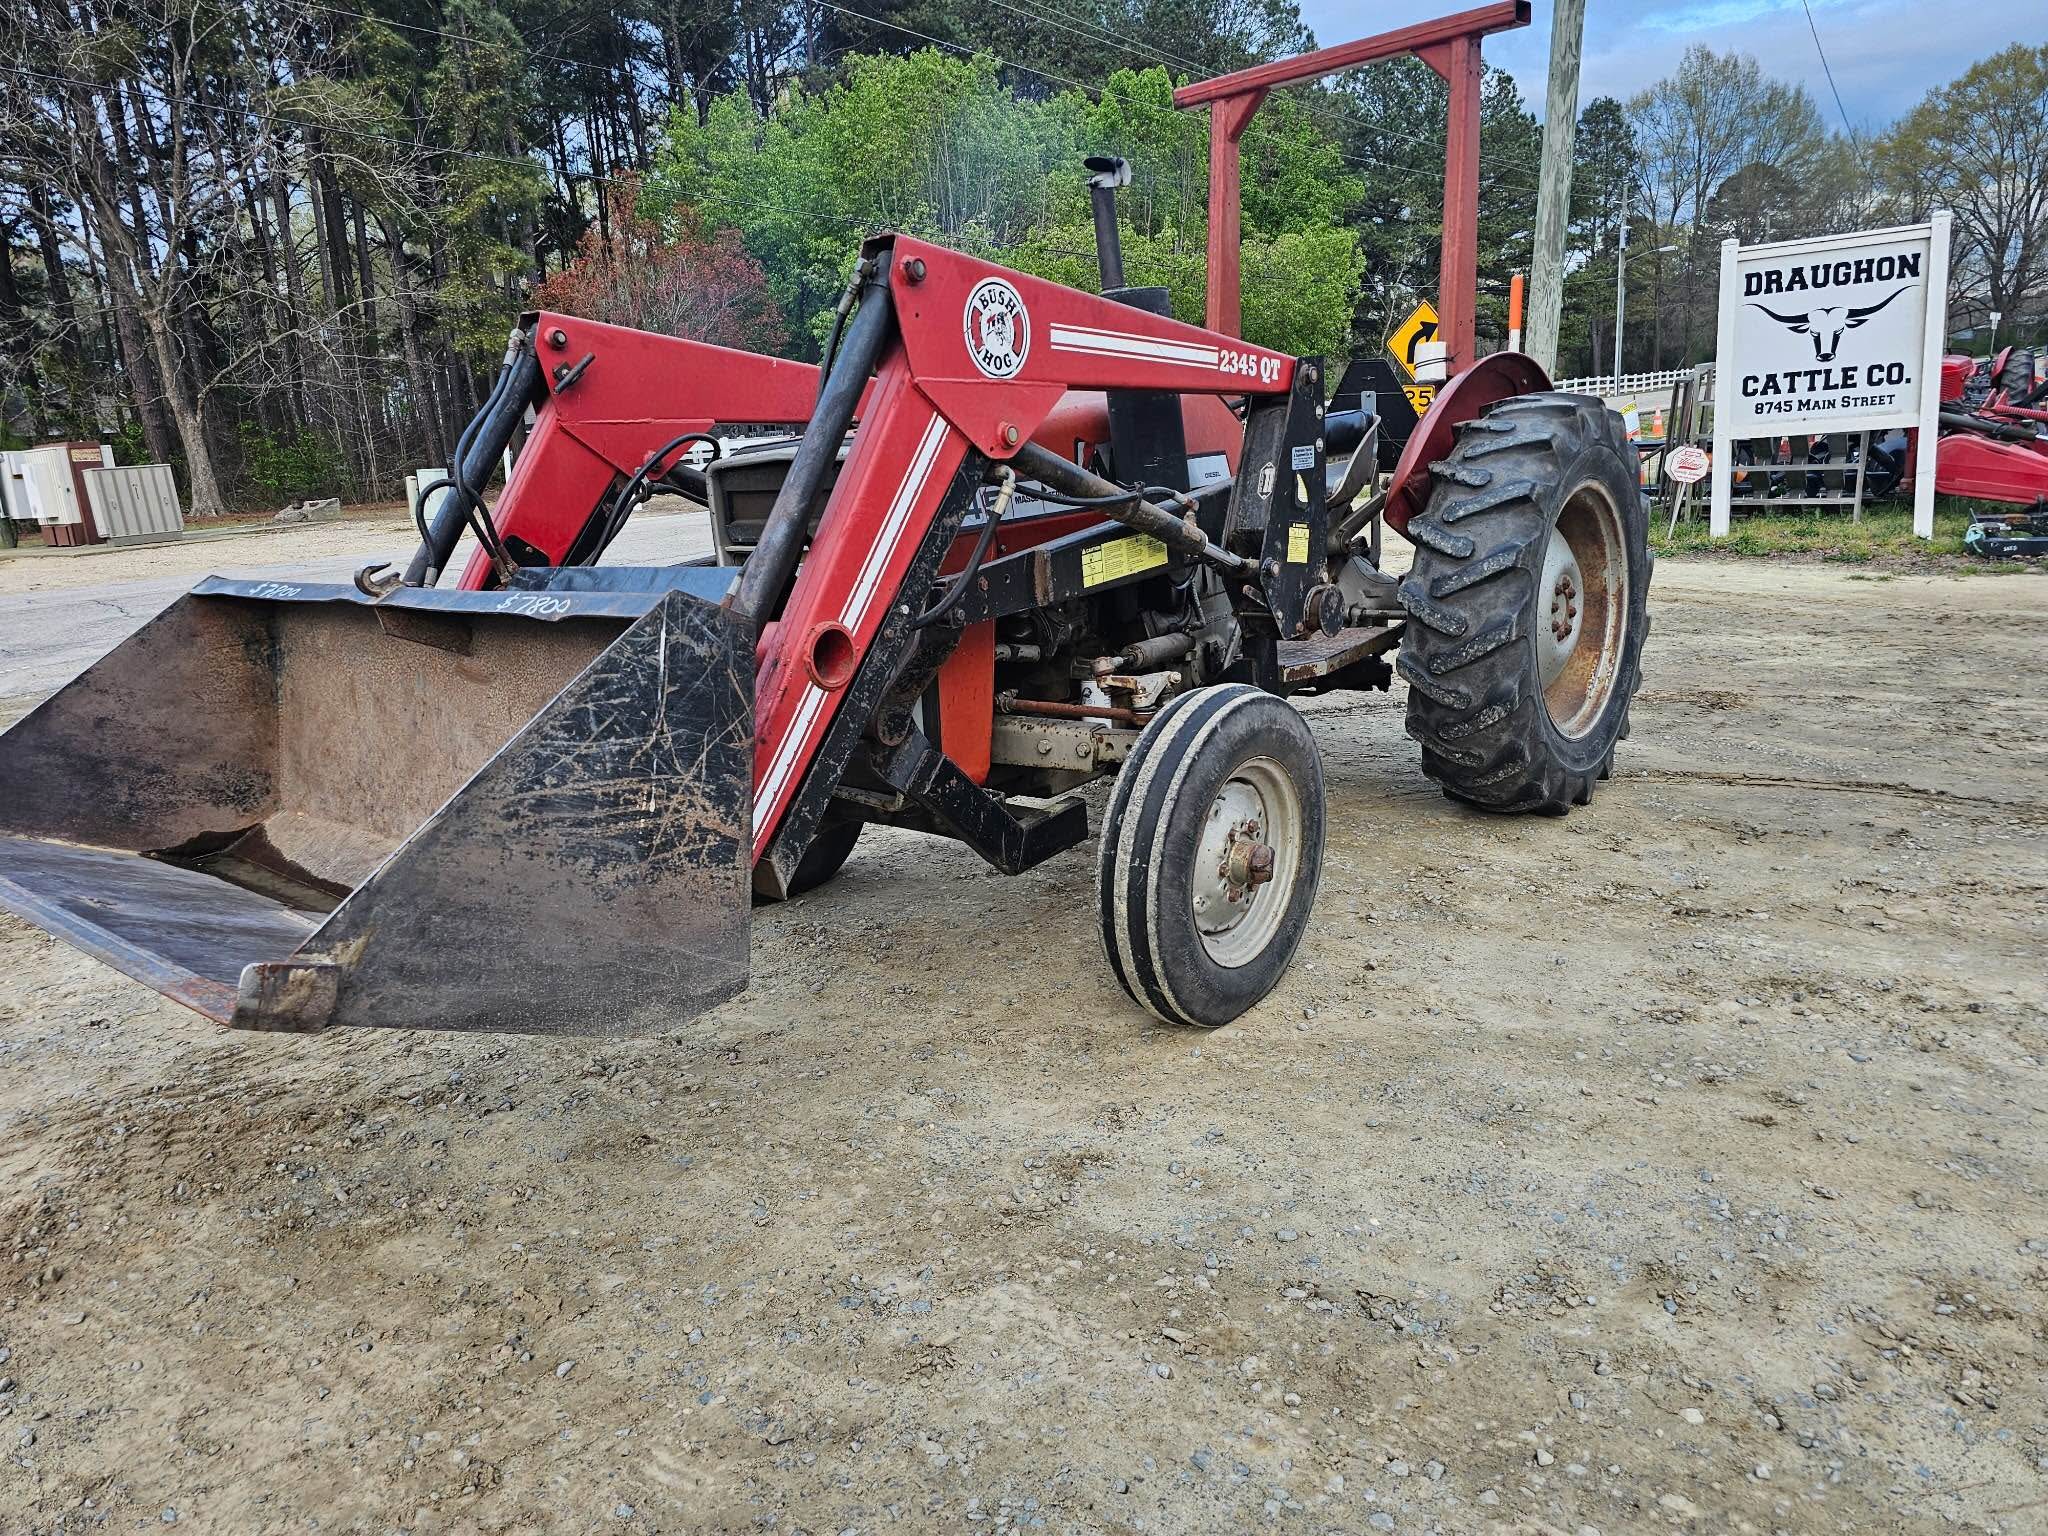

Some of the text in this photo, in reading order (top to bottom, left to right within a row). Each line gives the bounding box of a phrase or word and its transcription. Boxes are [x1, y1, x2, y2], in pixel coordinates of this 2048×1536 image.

[1744, 253, 1921, 297] DRAUGHON
[979, 289, 1017, 315] BUSH
[982, 349, 1012, 370] HOG
[1219, 349, 1281, 384] 2345 QT
[1742, 362, 1912, 398] CATTLE CO.
[1754, 400, 1793, 415] 8745
[496, 592, 571, 616] $7800
